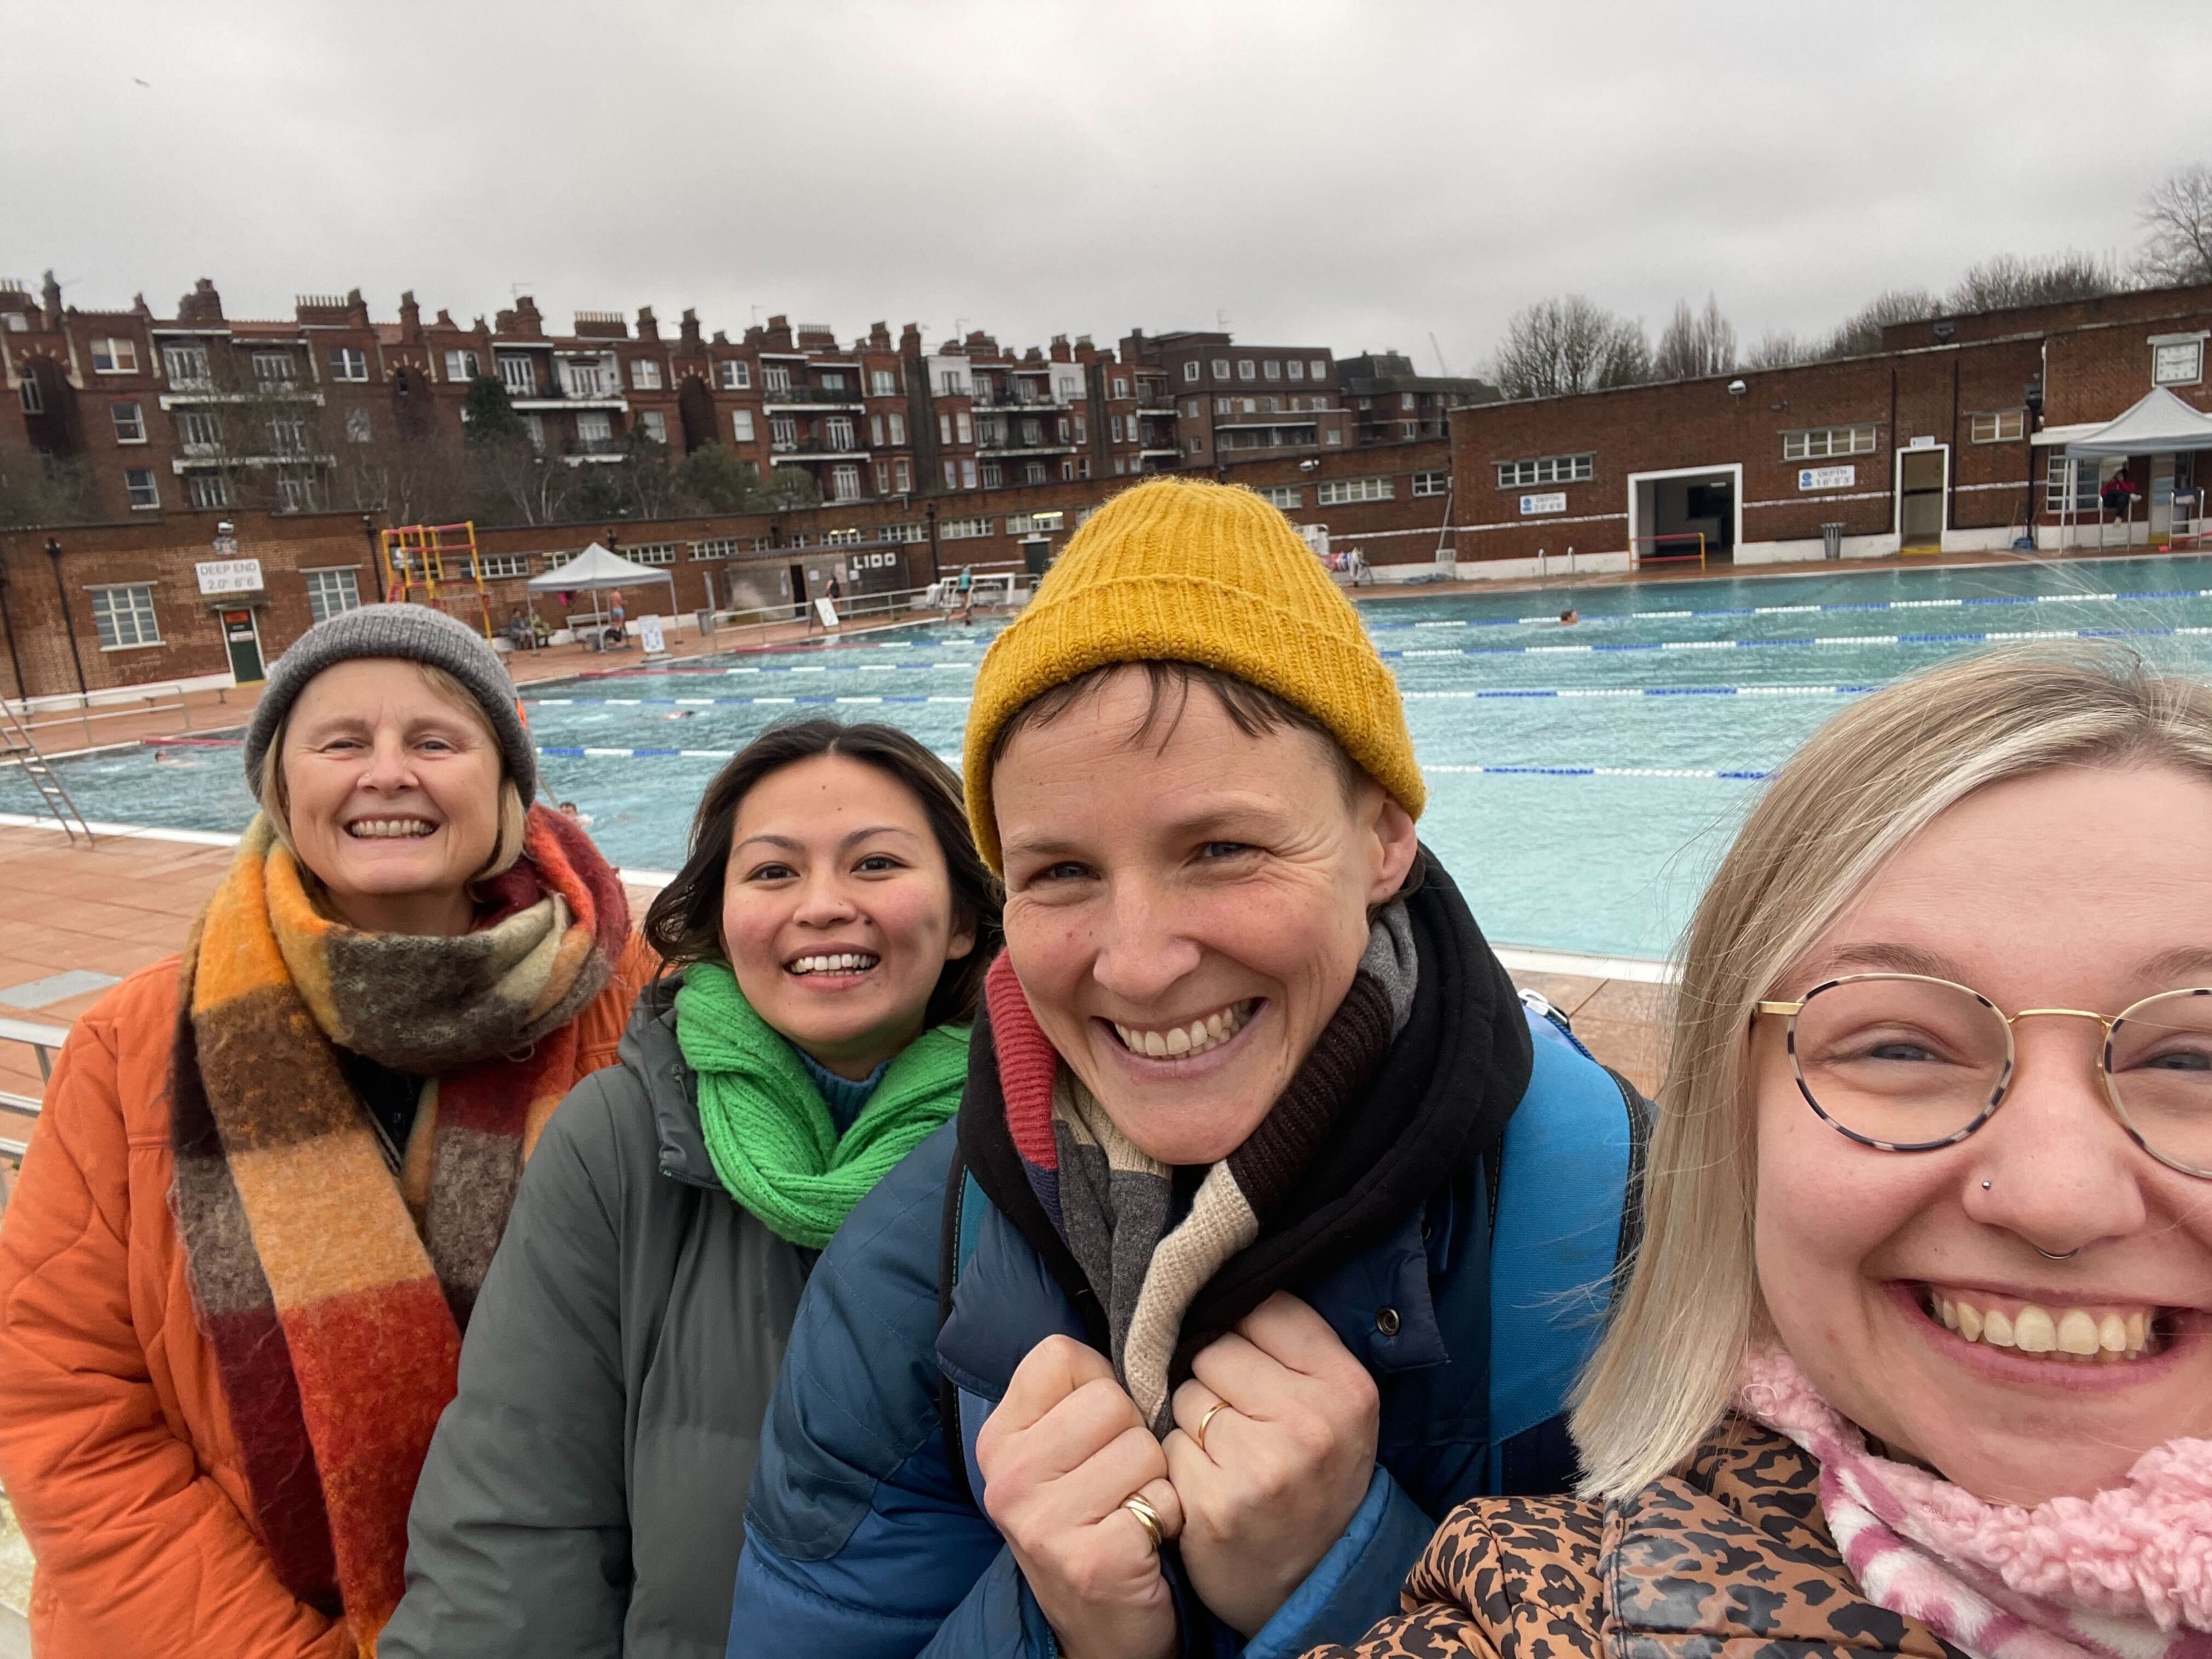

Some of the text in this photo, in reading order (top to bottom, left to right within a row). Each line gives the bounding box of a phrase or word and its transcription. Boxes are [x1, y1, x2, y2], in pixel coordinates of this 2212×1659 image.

[200, 562, 257, 575] DEEP END
[853, 552, 896, 570] LIDO
